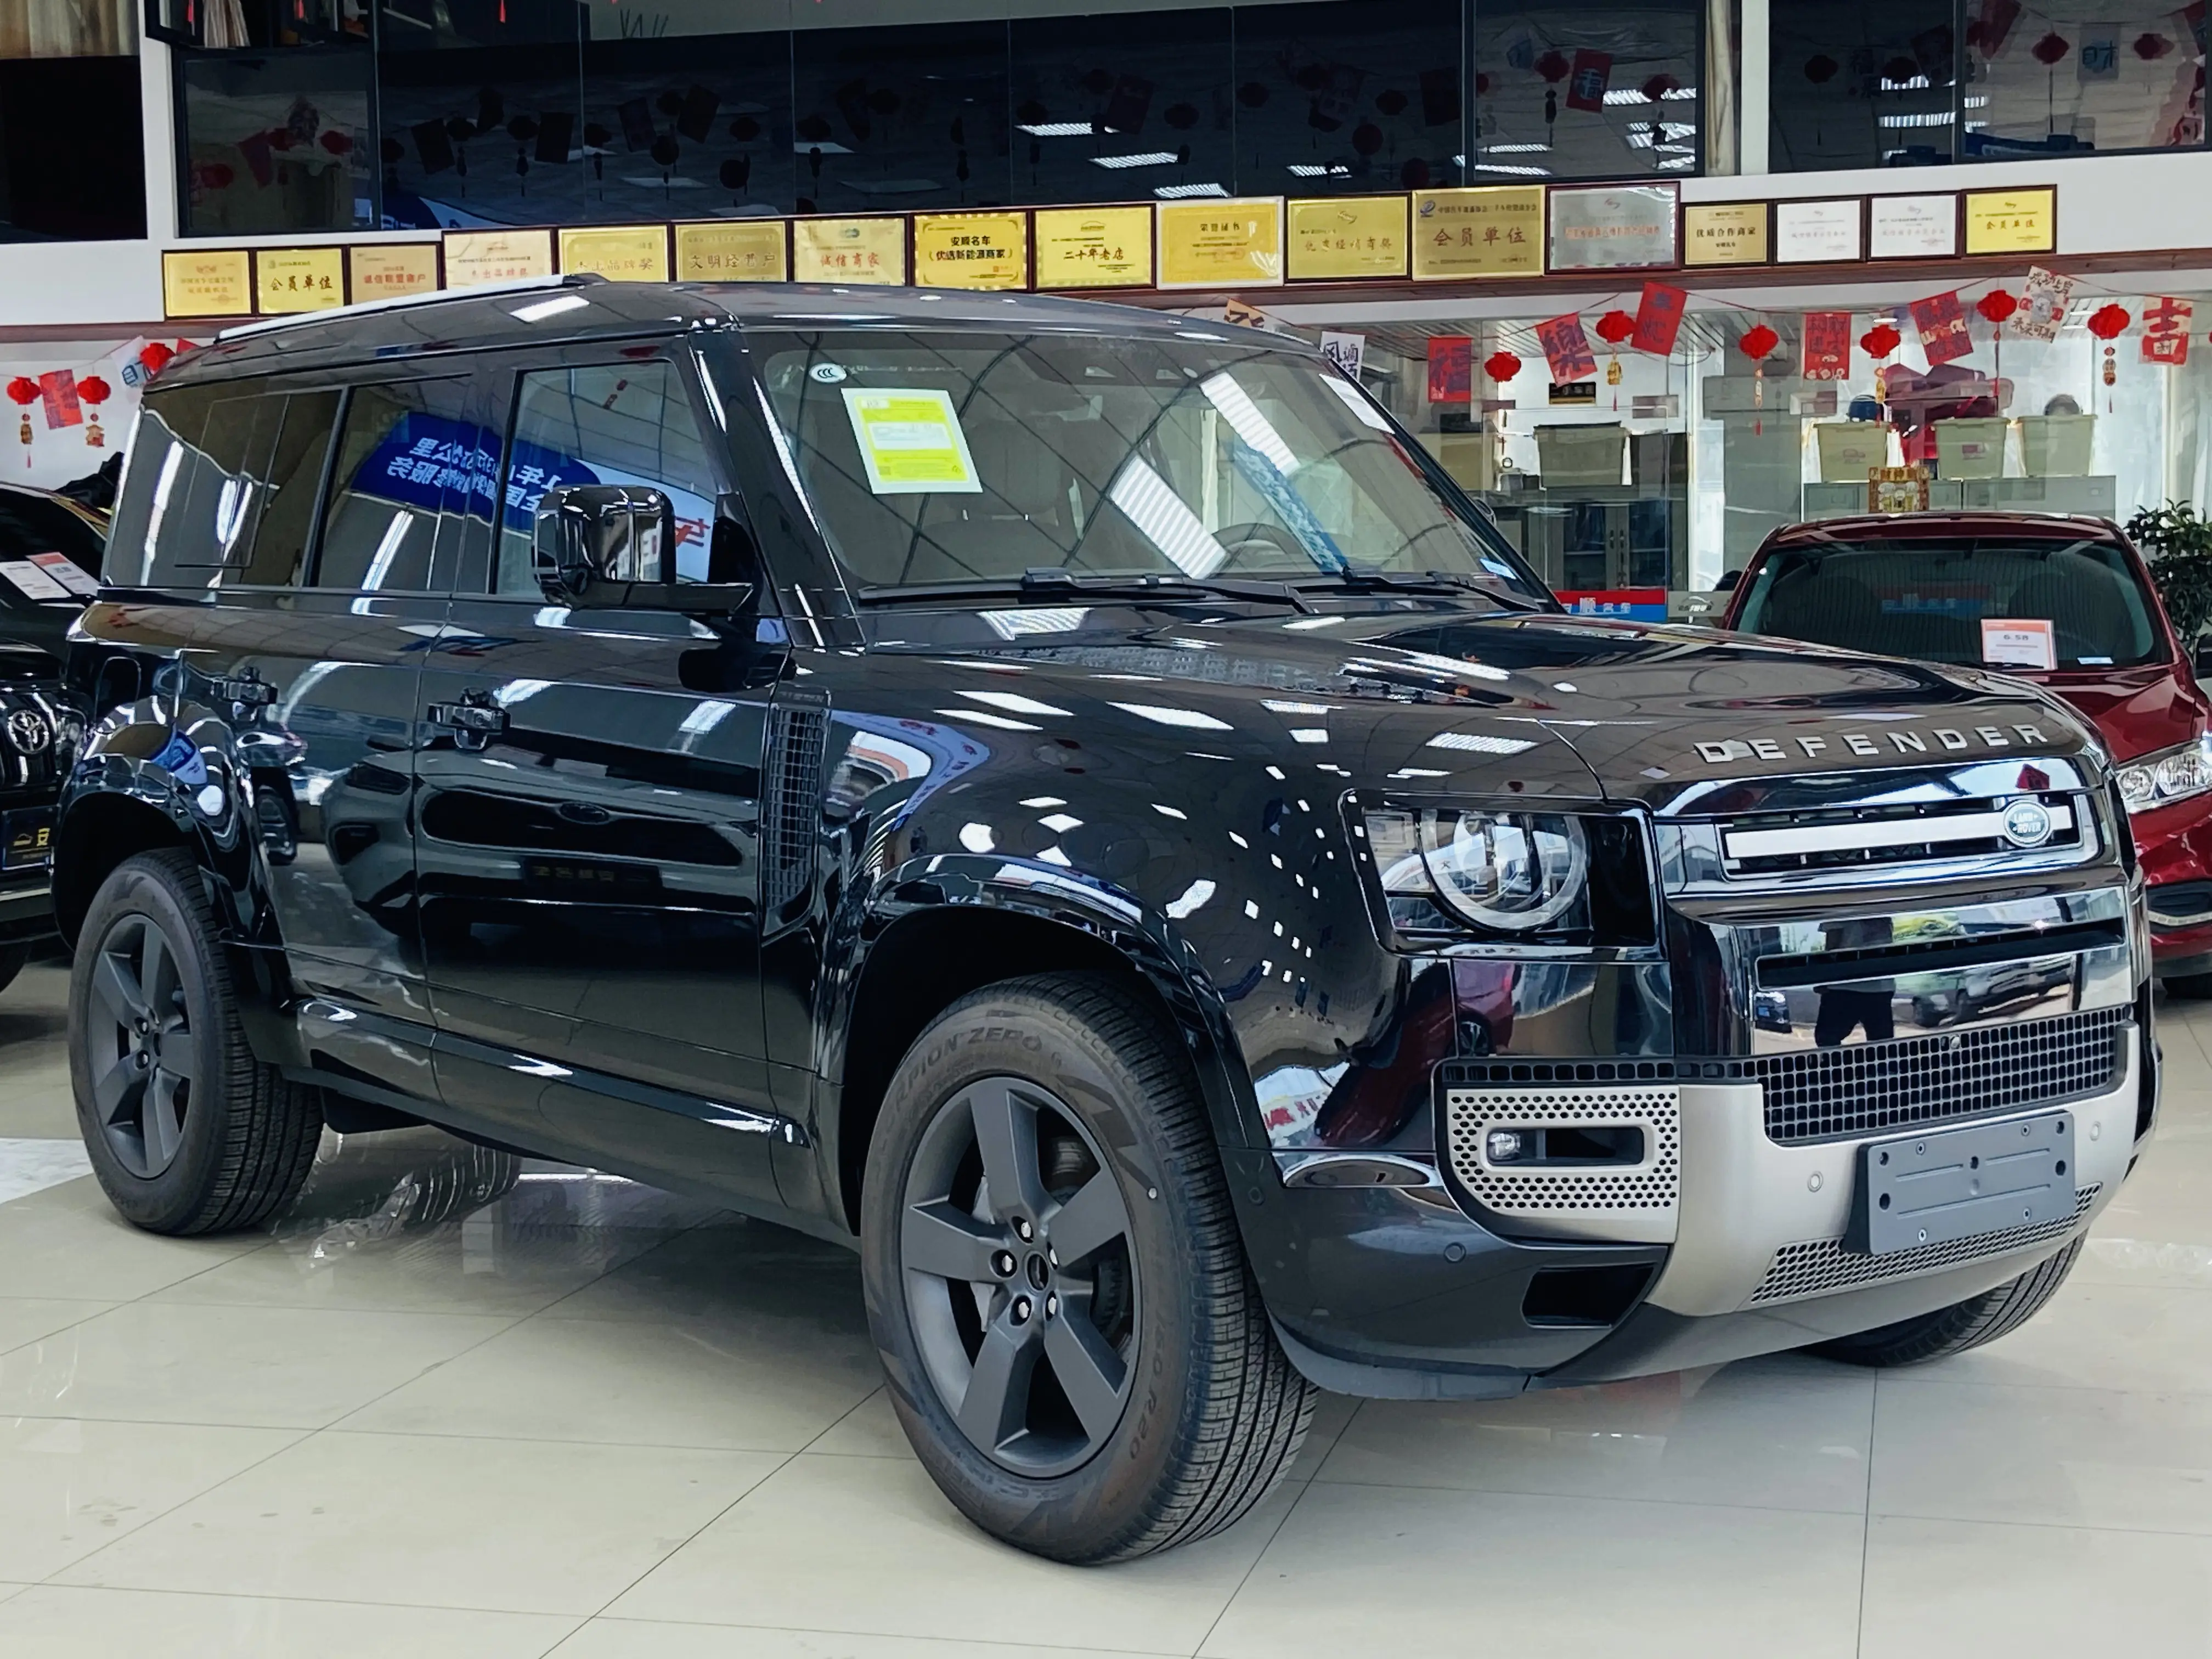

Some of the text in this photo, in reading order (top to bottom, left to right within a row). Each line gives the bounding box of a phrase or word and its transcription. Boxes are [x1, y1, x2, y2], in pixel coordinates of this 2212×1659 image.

[950, 235, 991, 246] 安顺名车
[1432, 226, 1526, 247] 会员单位
[690, 252, 775, 270] 文明经营户
[936, 249, 1006, 261] 优选新能源商家
[1063, 247, 1124, 261] 二十年老店
[270, 274, 333, 291] 会员单位
[1693, 724, 2049, 764] DEFENDER
